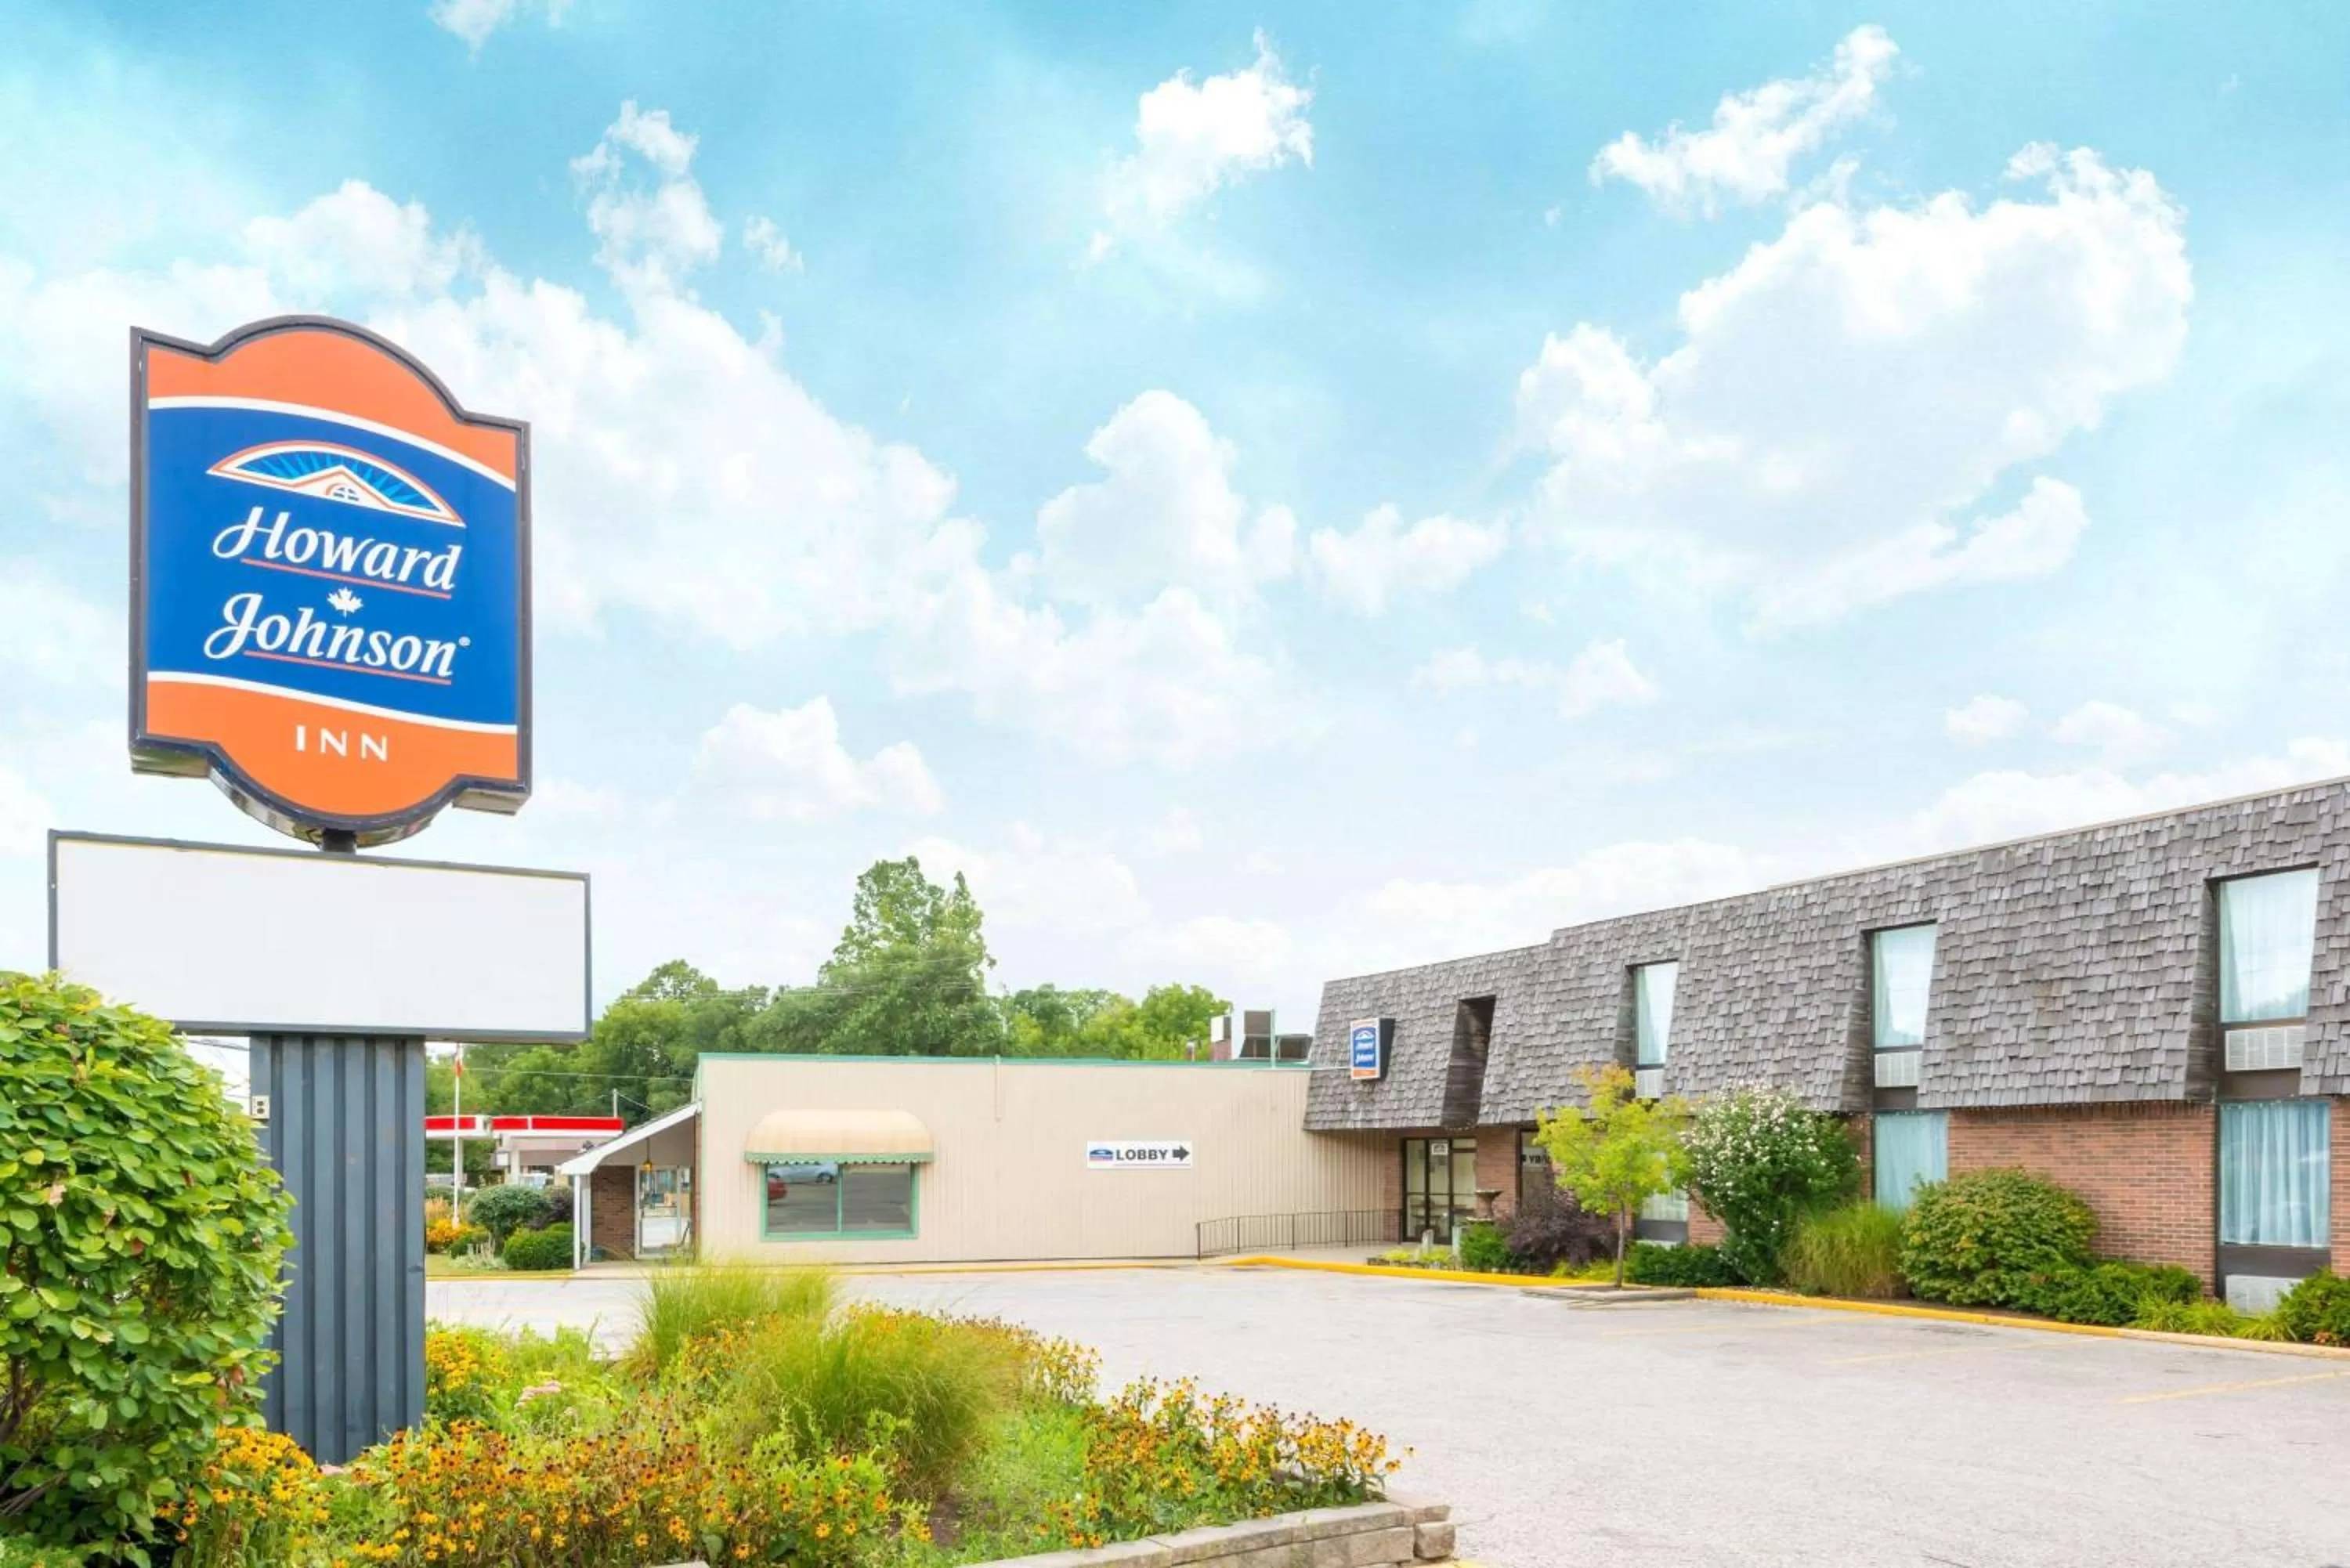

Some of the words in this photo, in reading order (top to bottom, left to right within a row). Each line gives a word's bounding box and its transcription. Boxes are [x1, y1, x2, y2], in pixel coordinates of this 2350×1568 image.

[212, 507, 462, 591] Howard
[295, 724, 388, 761] INN
[1116, 1149, 1169, 1161] LOBBY
